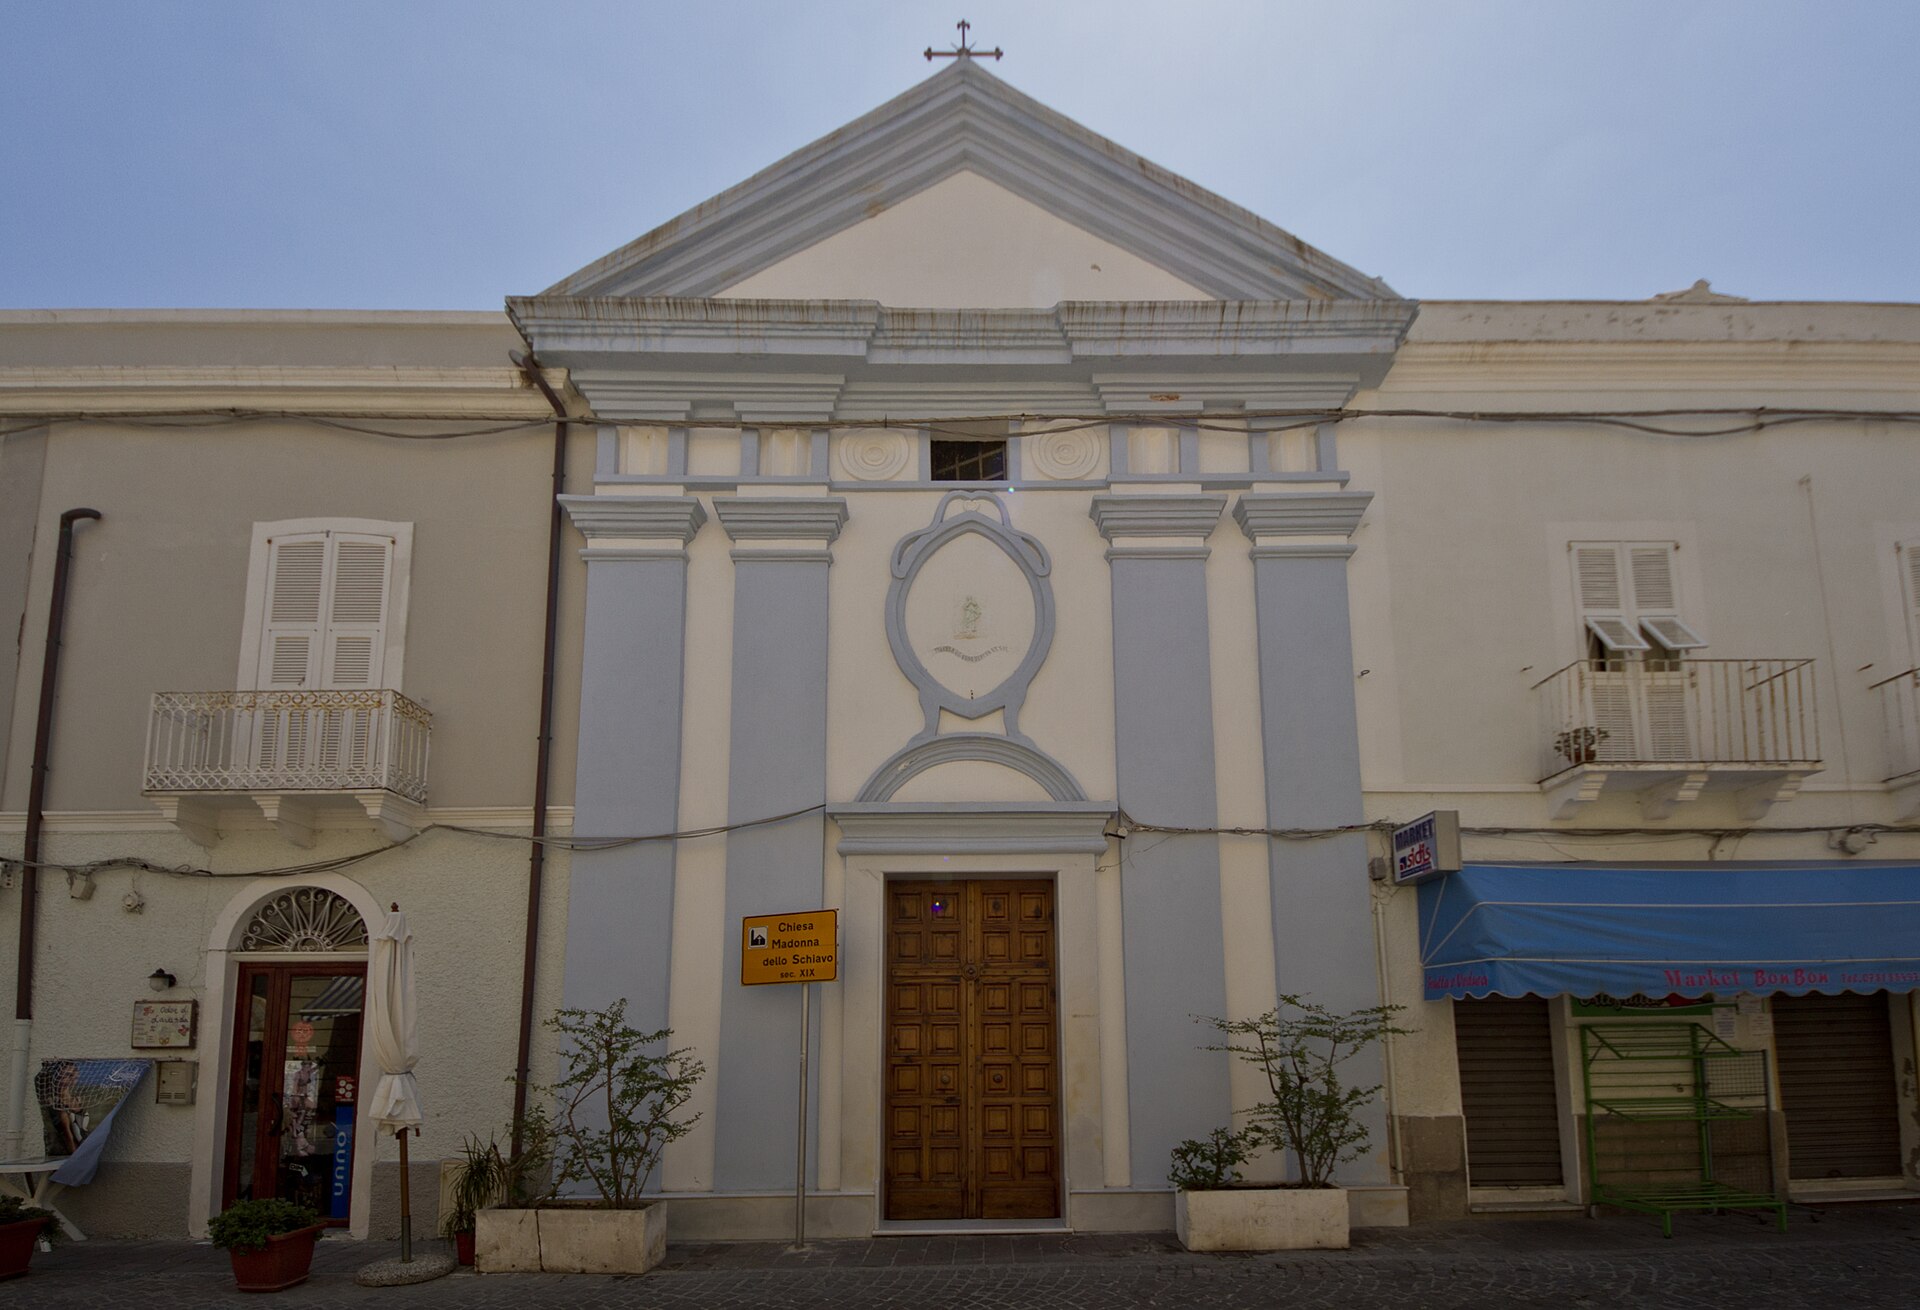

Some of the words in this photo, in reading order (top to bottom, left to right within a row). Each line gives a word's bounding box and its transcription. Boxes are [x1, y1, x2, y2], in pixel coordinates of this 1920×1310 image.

[1395, 818, 1433, 852] MARKET
[778, 922, 814, 933] Chiesa
[771, 938, 820, 949] Madonna
[762, 956, 788, 967] dello
[792, 954, 833, 965] Schiavo
[780, 971, 796, 979] sec.
[799, 968, 815, 978] XIX
[1664, 968, 1741, 987] Market
